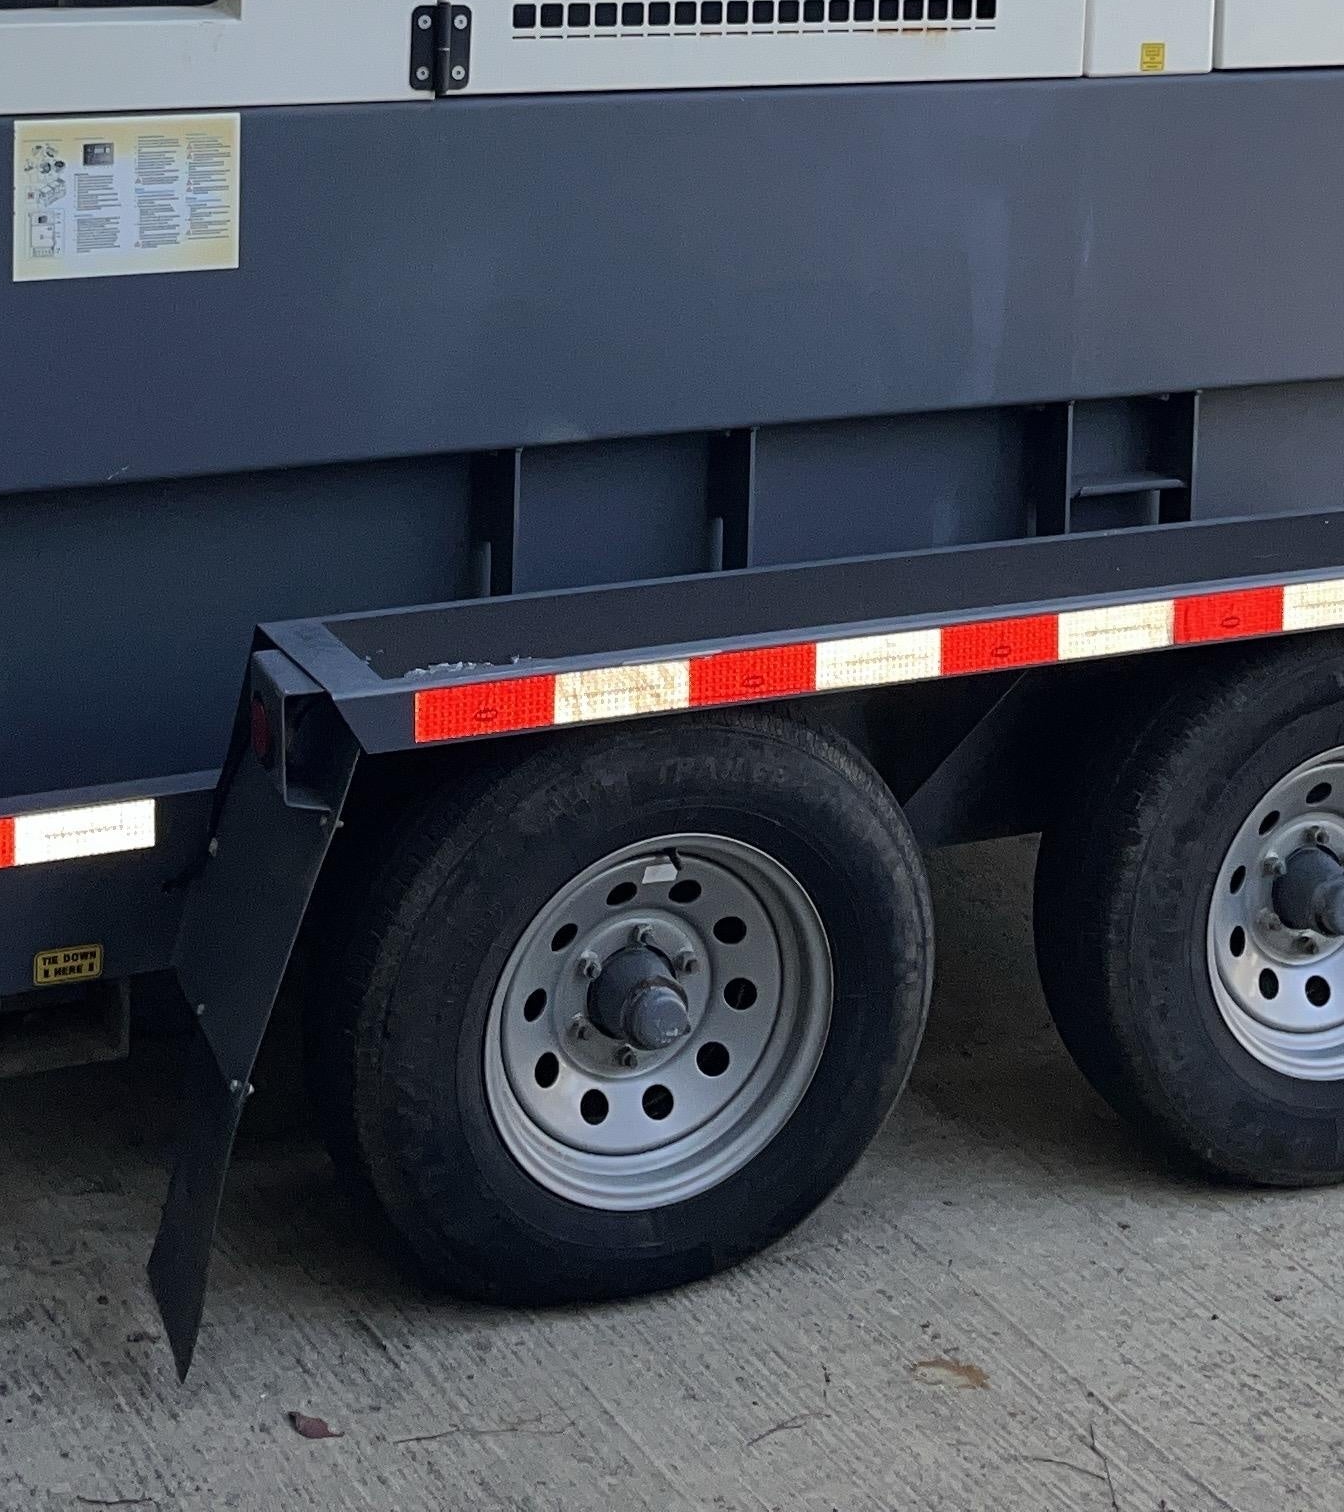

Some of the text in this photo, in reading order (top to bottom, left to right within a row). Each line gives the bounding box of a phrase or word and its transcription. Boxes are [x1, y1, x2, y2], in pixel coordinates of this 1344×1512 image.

[42, 950, 96, 966] TIE DOWN
[54, 964, 83, 977] HERE
